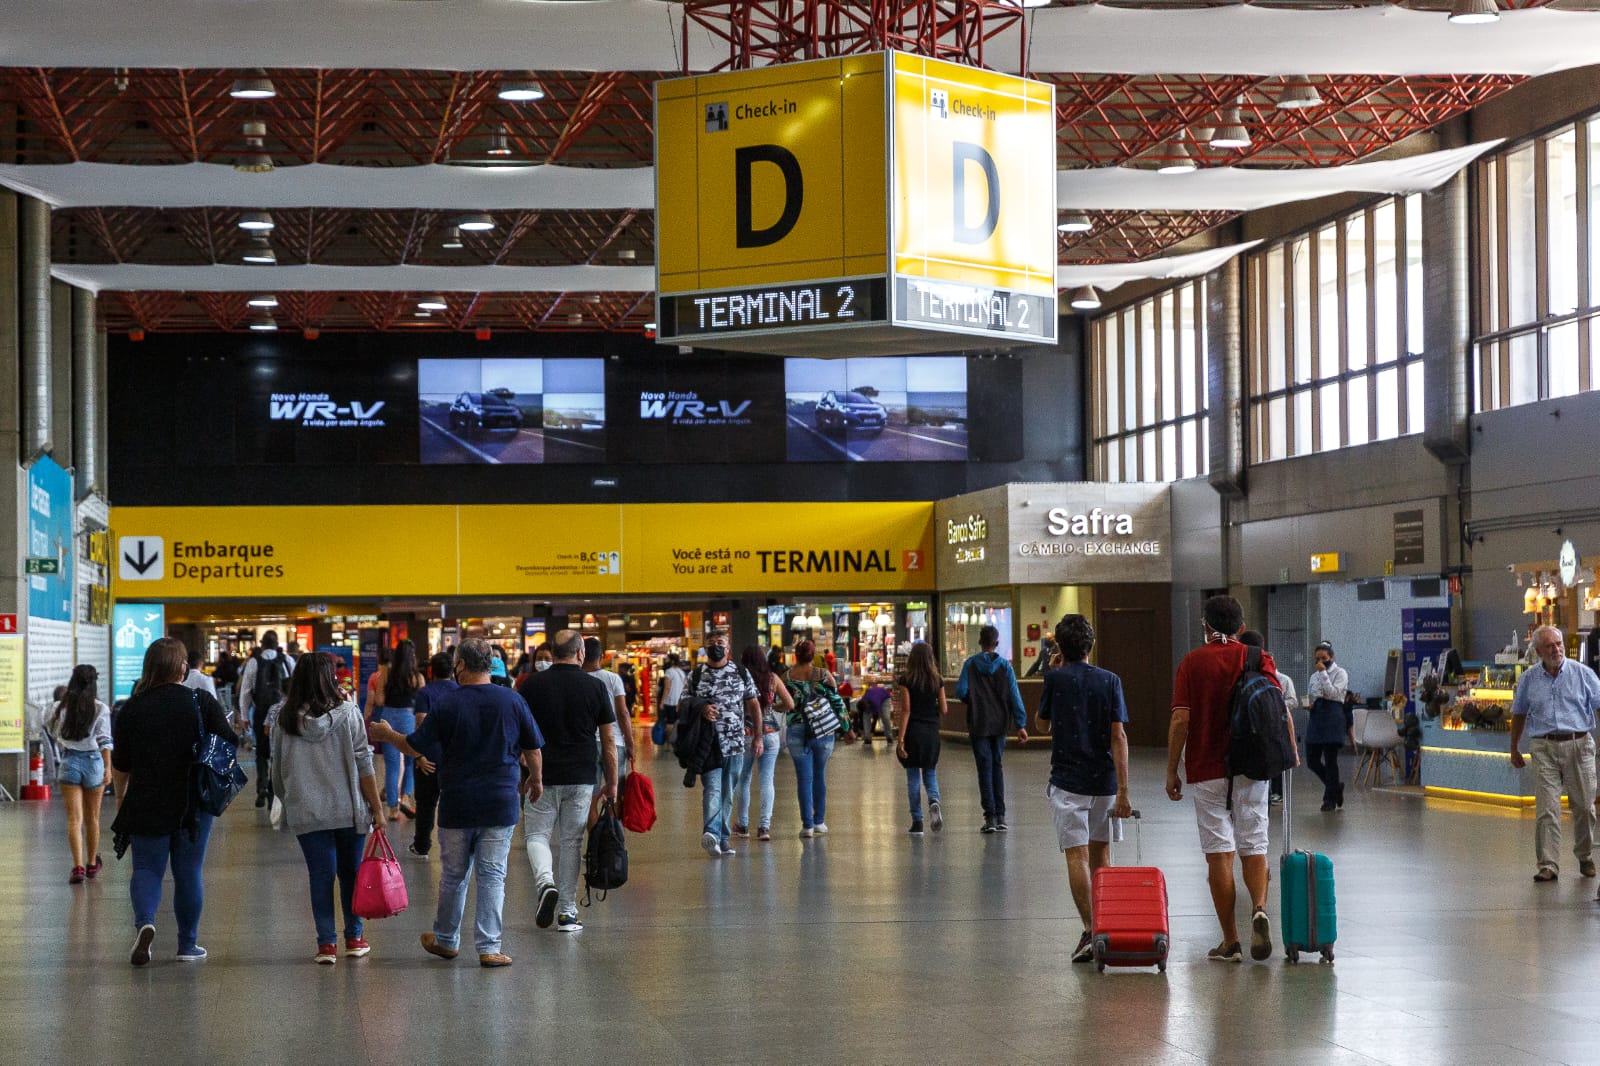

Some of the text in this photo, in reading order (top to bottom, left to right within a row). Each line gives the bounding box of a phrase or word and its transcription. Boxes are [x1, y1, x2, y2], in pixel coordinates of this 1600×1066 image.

[735, 99, 797, 120] Check-in
[953, 99, 996, 121] Check-in
[735, 144, 804, 249] D
[953, 140, 1001, 245] D
[694, 286, 855, 328] TERMINAL 2
[917, 284, 1030, 329] TERMINAL 2
[271, 393, 329, 401] Novo Honda
[640, 391, 697, 400] Novo Honda
[270, 401, 386, 420] WR-V
[640, 400, 752, 419] WR-V
[948, 514, 987, 544] Banco Safra
[1047, 507, 1134, 536] Safra
[173, 541, 274, 562] Embarque
[580, 552, 597, 563] B,C
[1020, 540, 1075, 555] CÂMBIO
[1085, 540, 1160, 555] EXCHANGE
[672, 548, 919, 573] Você está no TERMINAL 2
[672, 563, 733, 574] You are at
[173, 562, 284, 583] Departures
